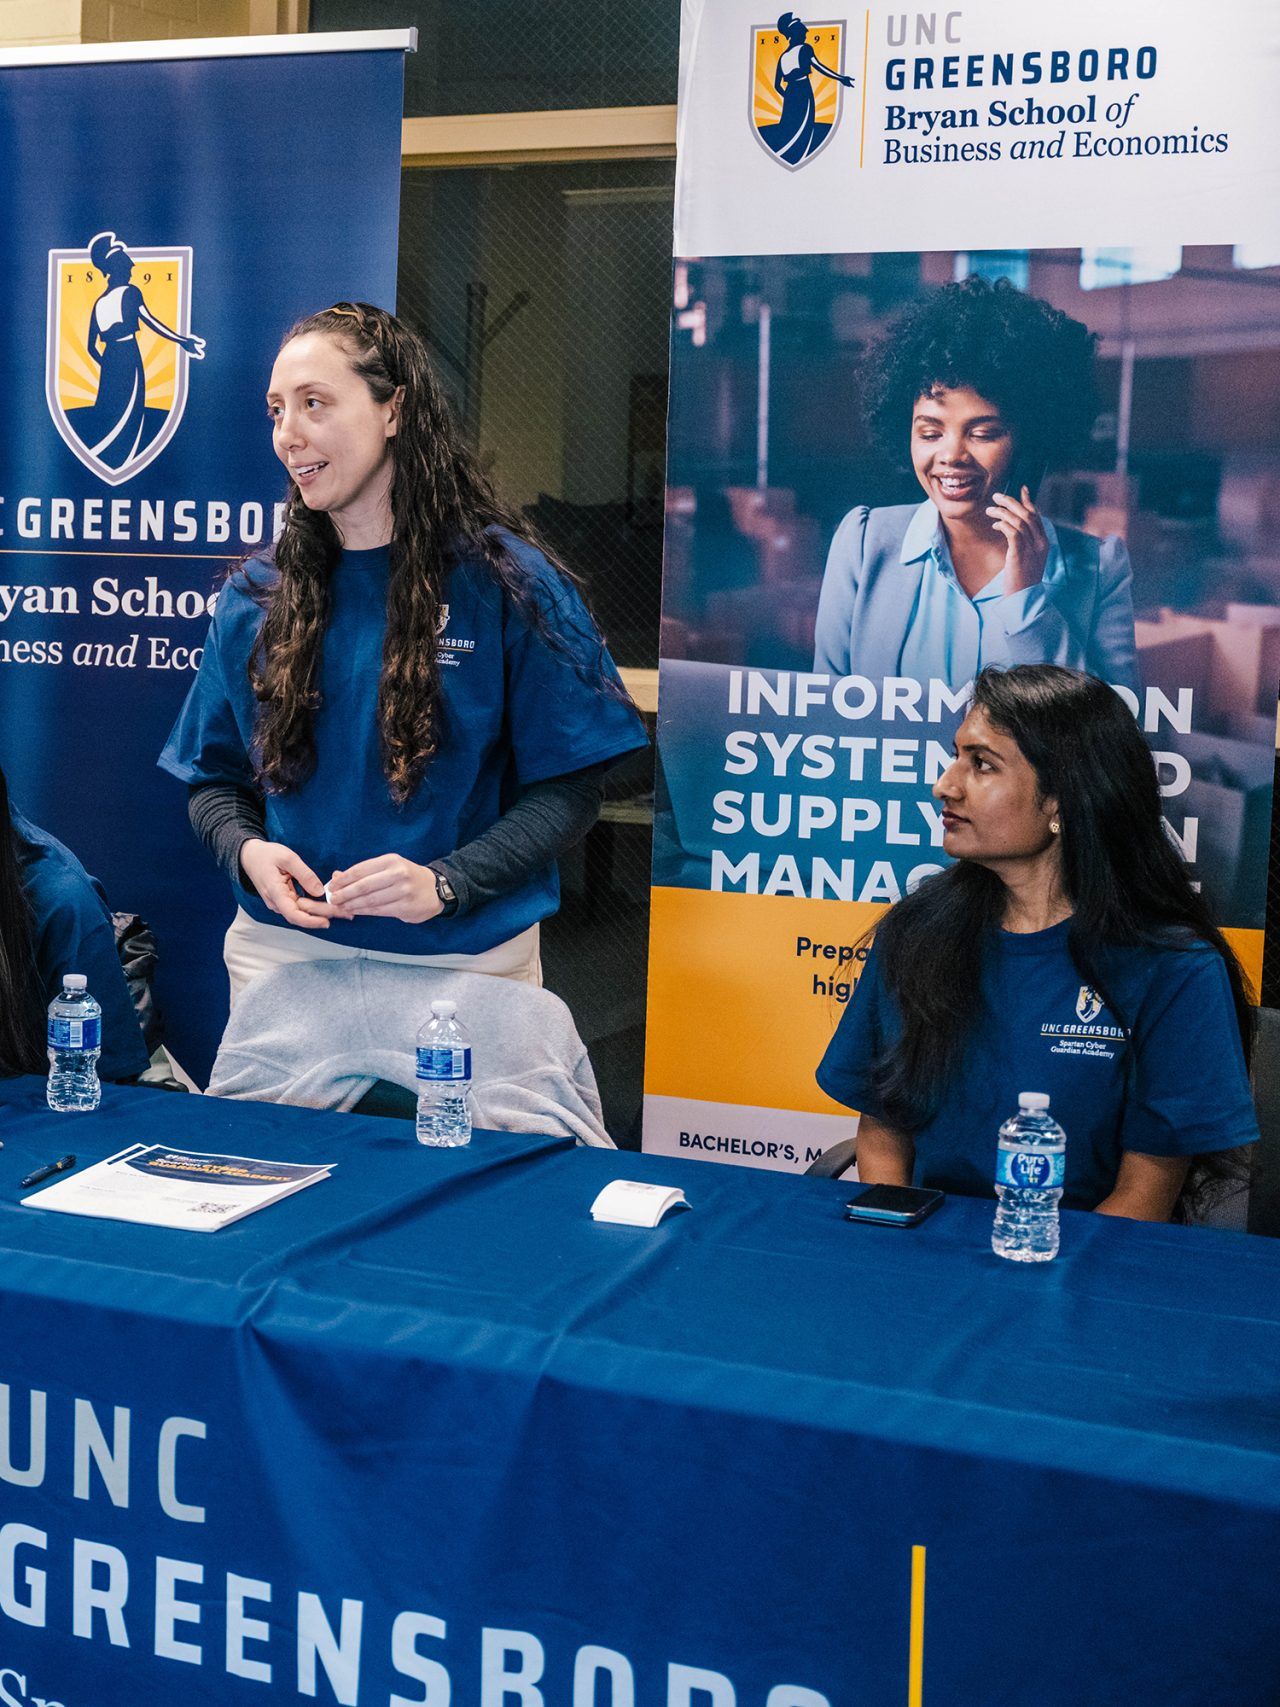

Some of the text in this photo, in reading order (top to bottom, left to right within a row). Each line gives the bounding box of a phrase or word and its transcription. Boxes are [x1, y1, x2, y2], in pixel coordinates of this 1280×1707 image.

[886, 10, 963, 47] UNC
[885, 45, 1158, 91] GREENSBORO
[884, 92, 1140, 137] Bryan School of
[882, 125, 1230, 165] Business and Economics
[71, 633, 140, 669] and
[711, 790, 946, 848] SUPPLY
[1040, 1022, 1062, 1033] UNC
[1049, 1046, 1116, 1060] Guardian Academy
[1058, 1040, 1107, 1051] Spartan Cyber
[678, 1131, 800, 1164] BACHELOR'S,
[1017, 1153, 1046, 1167] Pure
[1020, 1164, 1042, 1178] Life
